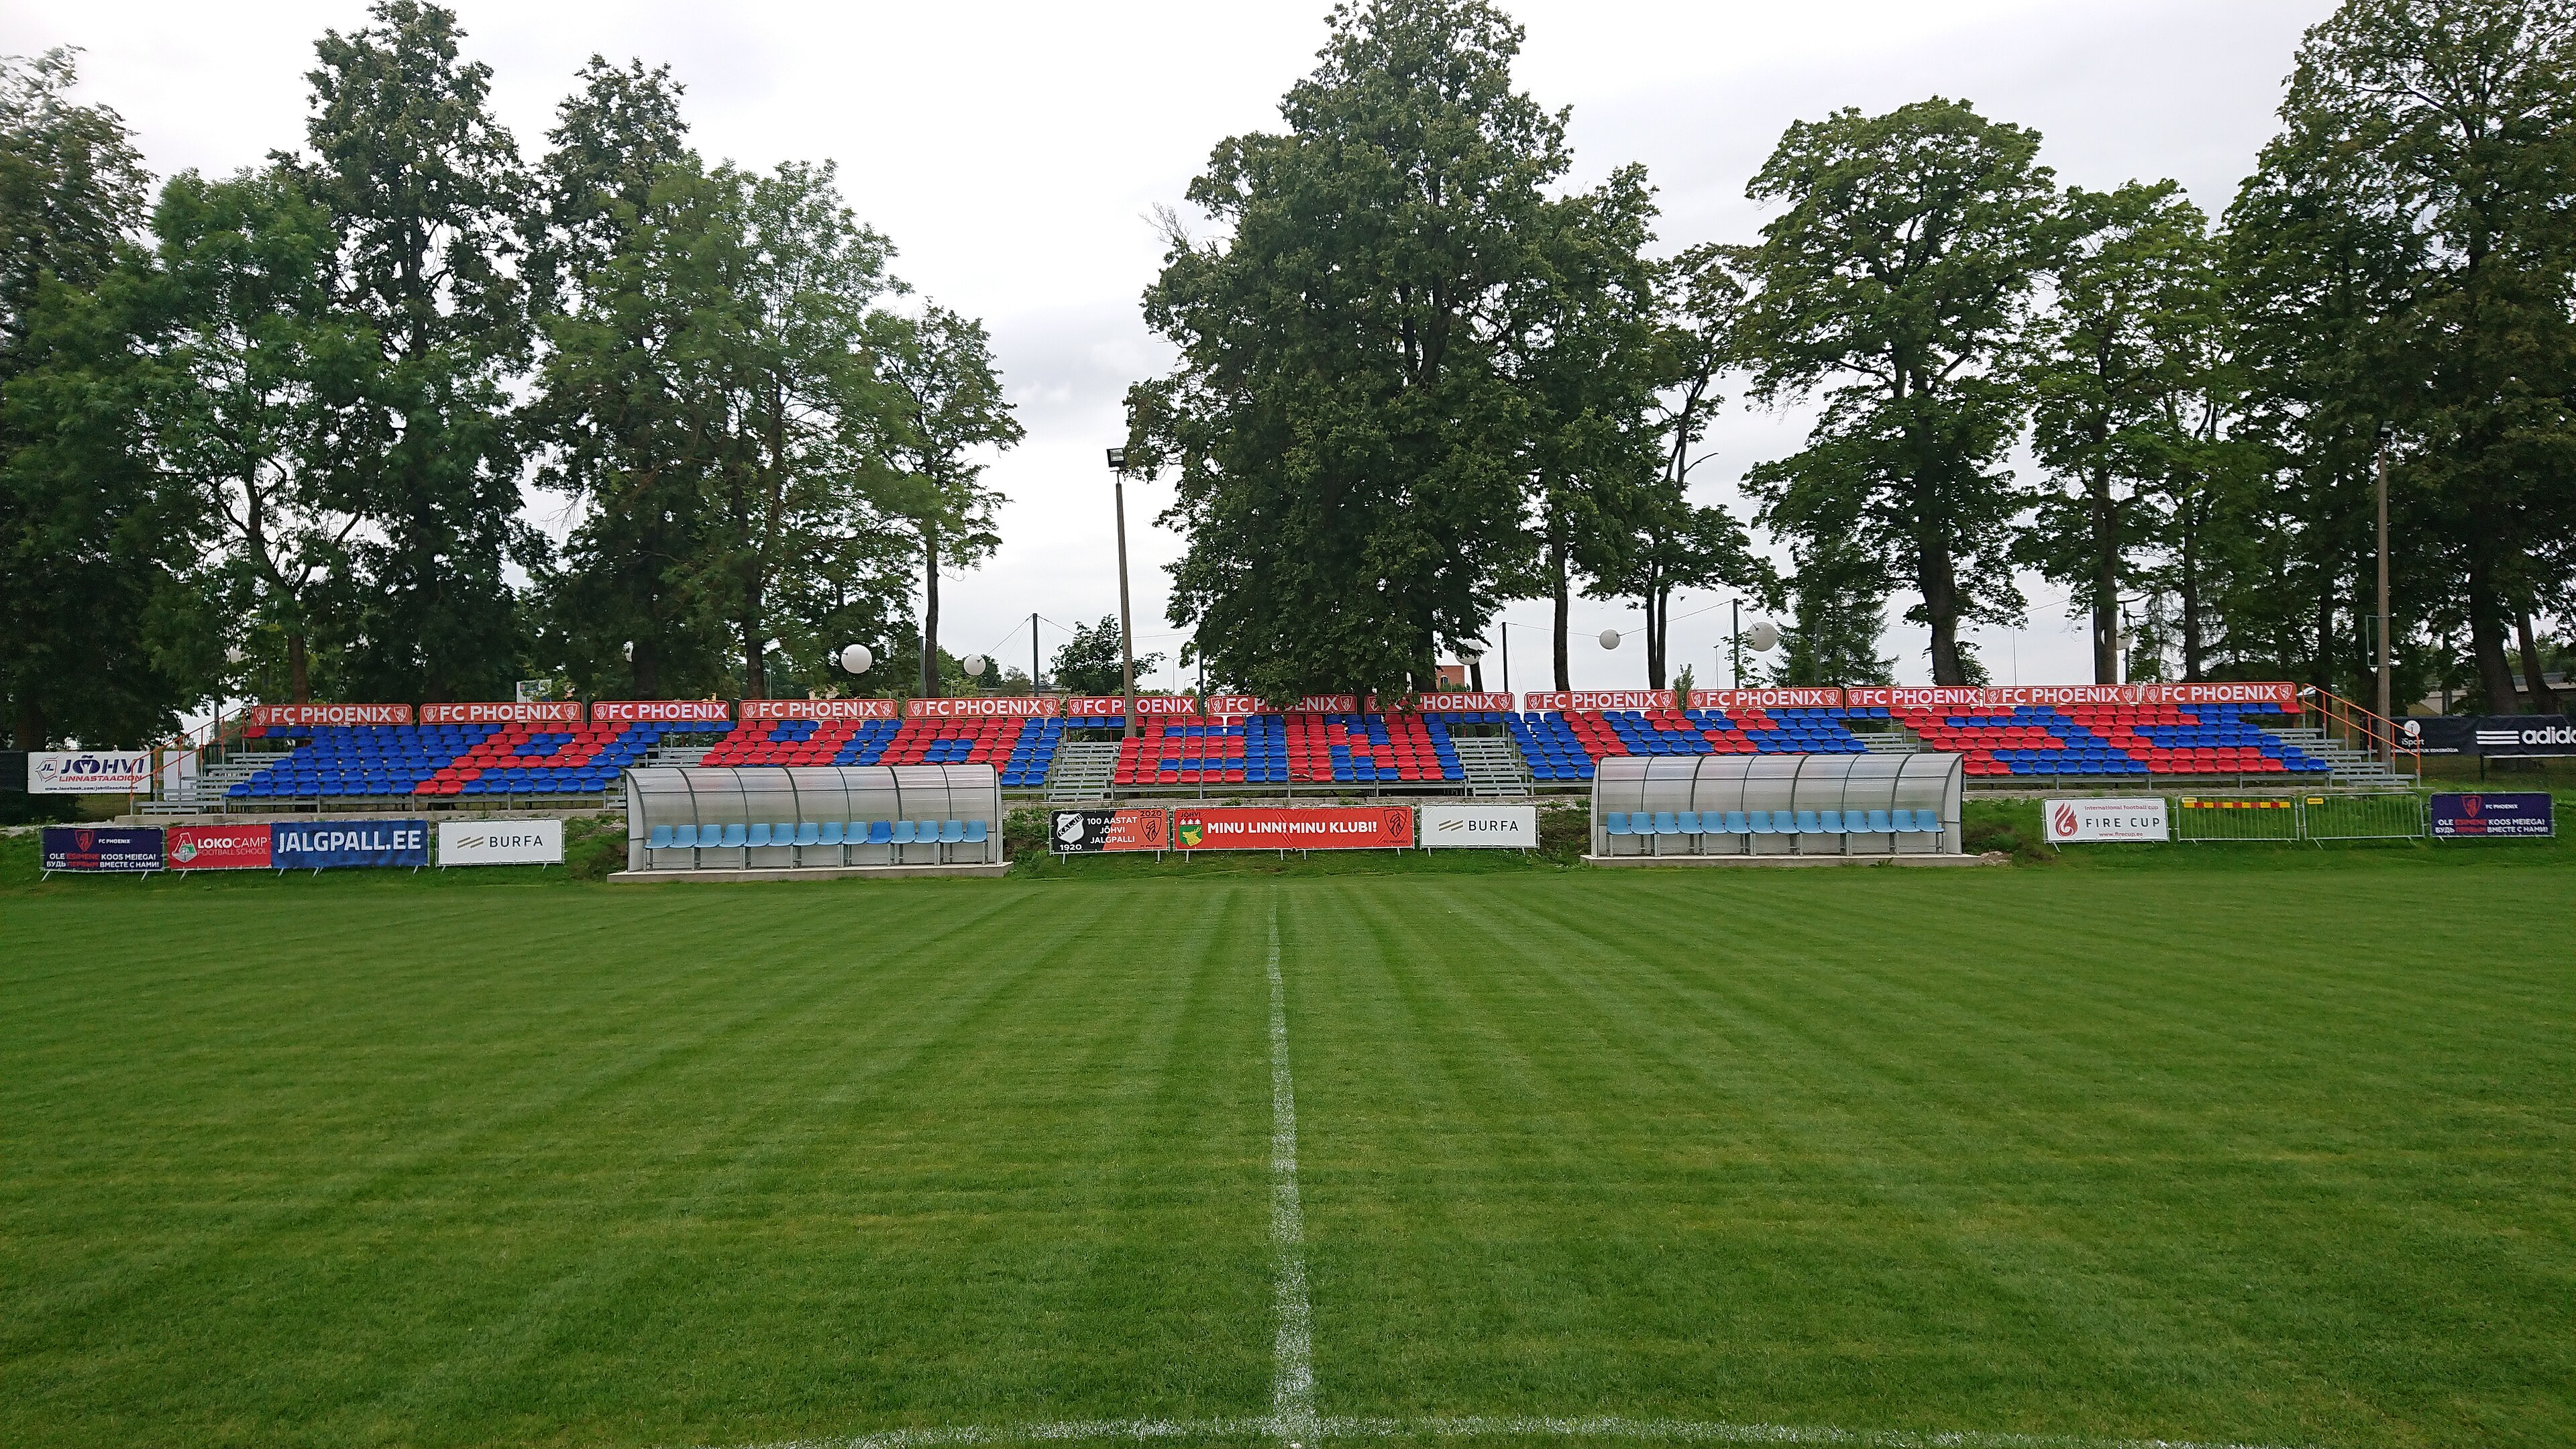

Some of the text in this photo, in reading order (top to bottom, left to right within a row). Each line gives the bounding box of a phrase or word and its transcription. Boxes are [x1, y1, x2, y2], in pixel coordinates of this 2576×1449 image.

[1543, 692, 1658, 708] FC PHOENIX
[1706, 690, 1823, 706] FC PHOENIX
[1863, 690, 1978, 704] FC PHOENIX
[2002, 687, 2120, 702] FC PHOENIX
[2161, 686, 2277, 701] FC PHOENIX
[926, 700, 1041, 715] FC PHOENIX
[1083, 699, 1194, 713] FC POENIX
[1226, 698, 1248, 712] FC
[1420, 694, 1496, 710] HOENIX
[271, 706, 392, 722] FC PHOENIX
[439, 704, 561, 721] FC PHOENIX
[609, 704, 727, 718] FC PHOENIX
[759, 702, 878, 717] FC PHOENIX
[60, 755, 145, 774] JÕHVI
[1058, 814, 1081, 836] KALJU
[1103, 816, 1137, 824] AASTAT
[1468, 820, 1519, 831] BURFA
[2086, 818, 2159, 828] FIRE CUP
[1099, 825, 1125, 834] JÕHVI
[1208, 821, 1377, 834] MINU LINN! MINU KLUBI!
[198, 837, 268, 849] LOKOCAMP
[277, 830, 422, 854] JALGPALL.EE
[489, 835, 543, 848] BURFA
[1090, 836, 1135, 844] JALGPALLI
